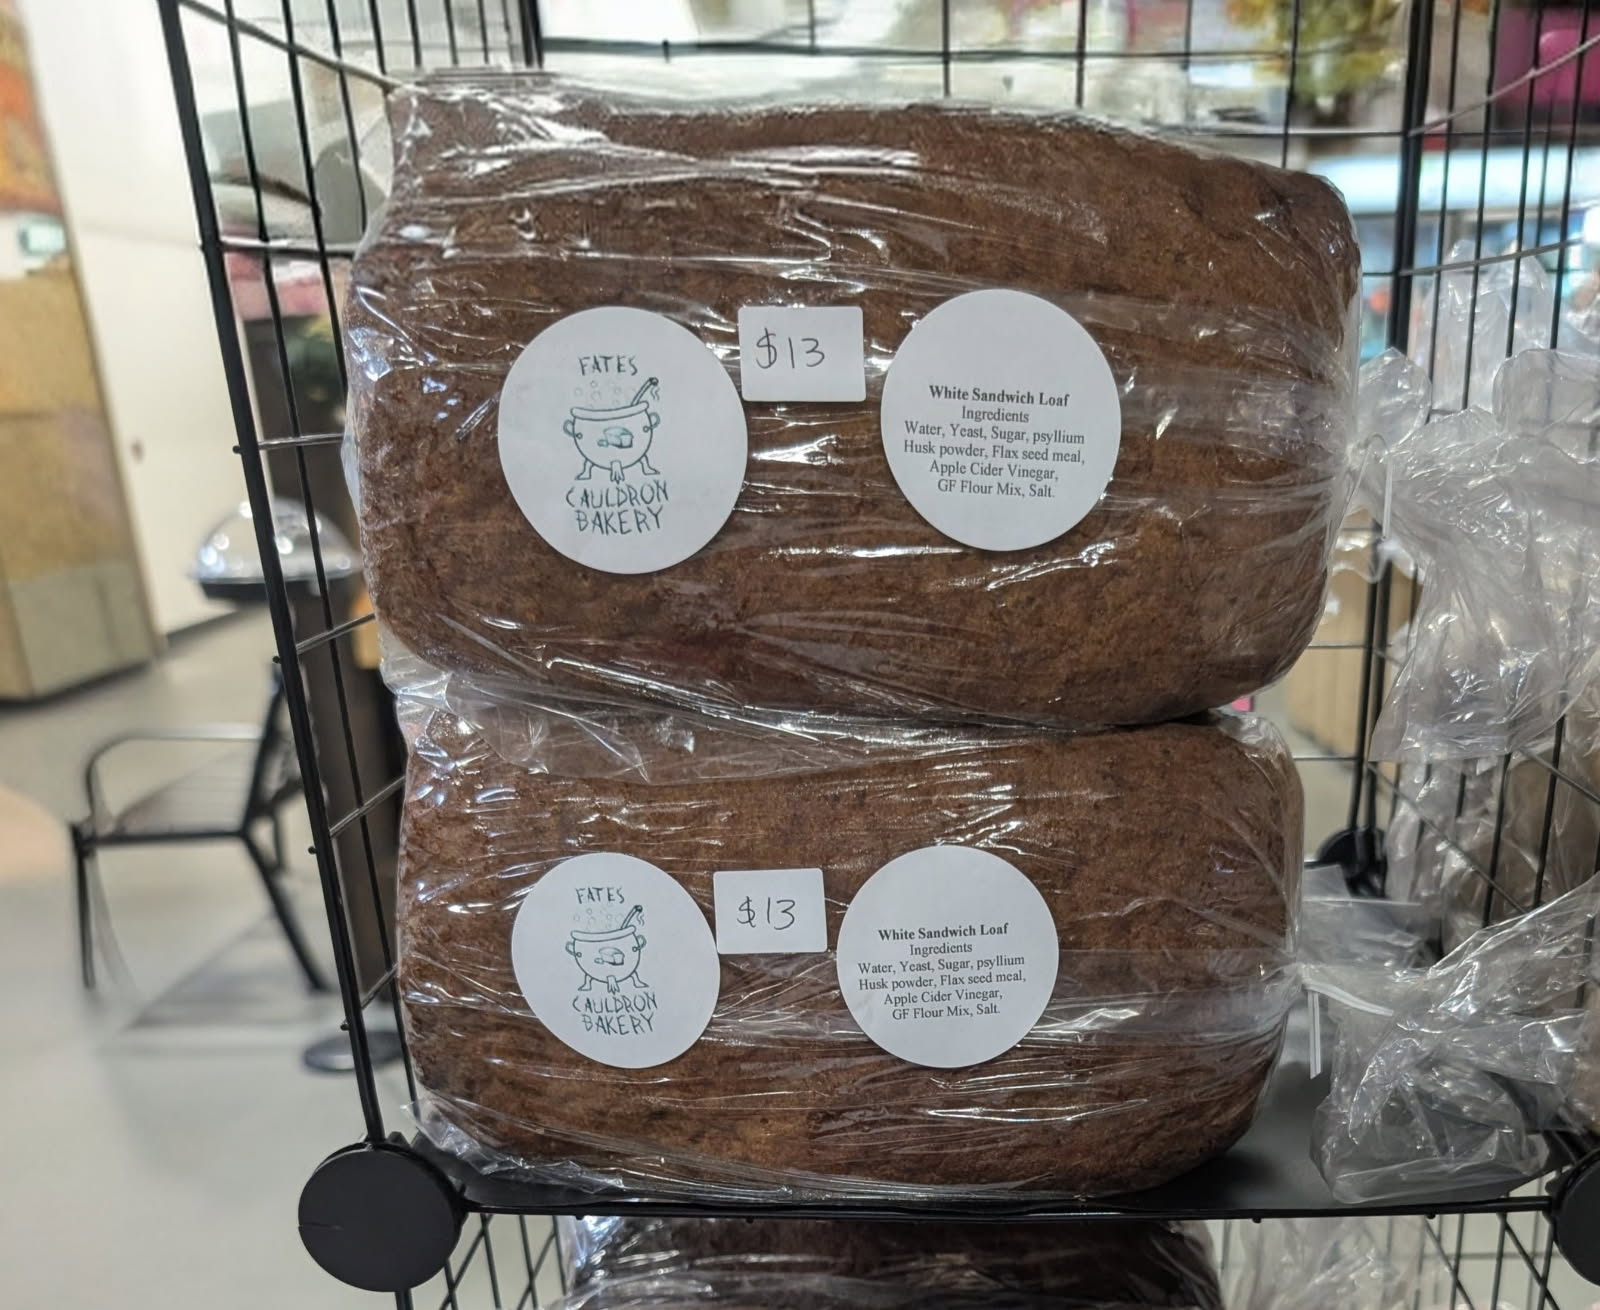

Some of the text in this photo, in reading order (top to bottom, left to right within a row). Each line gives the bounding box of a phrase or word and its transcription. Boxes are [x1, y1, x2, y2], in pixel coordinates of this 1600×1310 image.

[756, 327, 825, 369] $13
[578, 354, 638, 376] FATES
[929, 385, 1070, 407] White Sandwich Loaf
[962, 406, 1029, 423] Ingredients
[905, 420, 1085, 445] Water, Yeast, Sugar, psyllium
[904, 439, 1085, 466] Husk powder, Flax seed meal,
[929, 459, 1059, 481] Apple Cider Vinegar,
[565, 480, 669, 510] CAULDRON
[937, 479, 1055, 499] GF Flour Mix, Salt.
[576, 506, 663, 536] BAKERY
[575, 887, 625, 904] FATES
[737, 896, 795, 930] $13
[878, 923, 1009, 941] White Sandwich Loaf
[910, 943, 973, 958] Ingredients
[858, 955, 1025, 975] Water, Yeast, Sugar, psyllium
[859, 970, 1026, 991] Husk powder, Flax seed meal,
[572, 992, 658, 1014] CAULDRON
[884, 988, 1003, 1007] Apple Cider Vinegar,
[892, 1003, 1000, 1020] GF Flour Mix, Salt.
[583, 1013, 655, 1035] BAKERY
